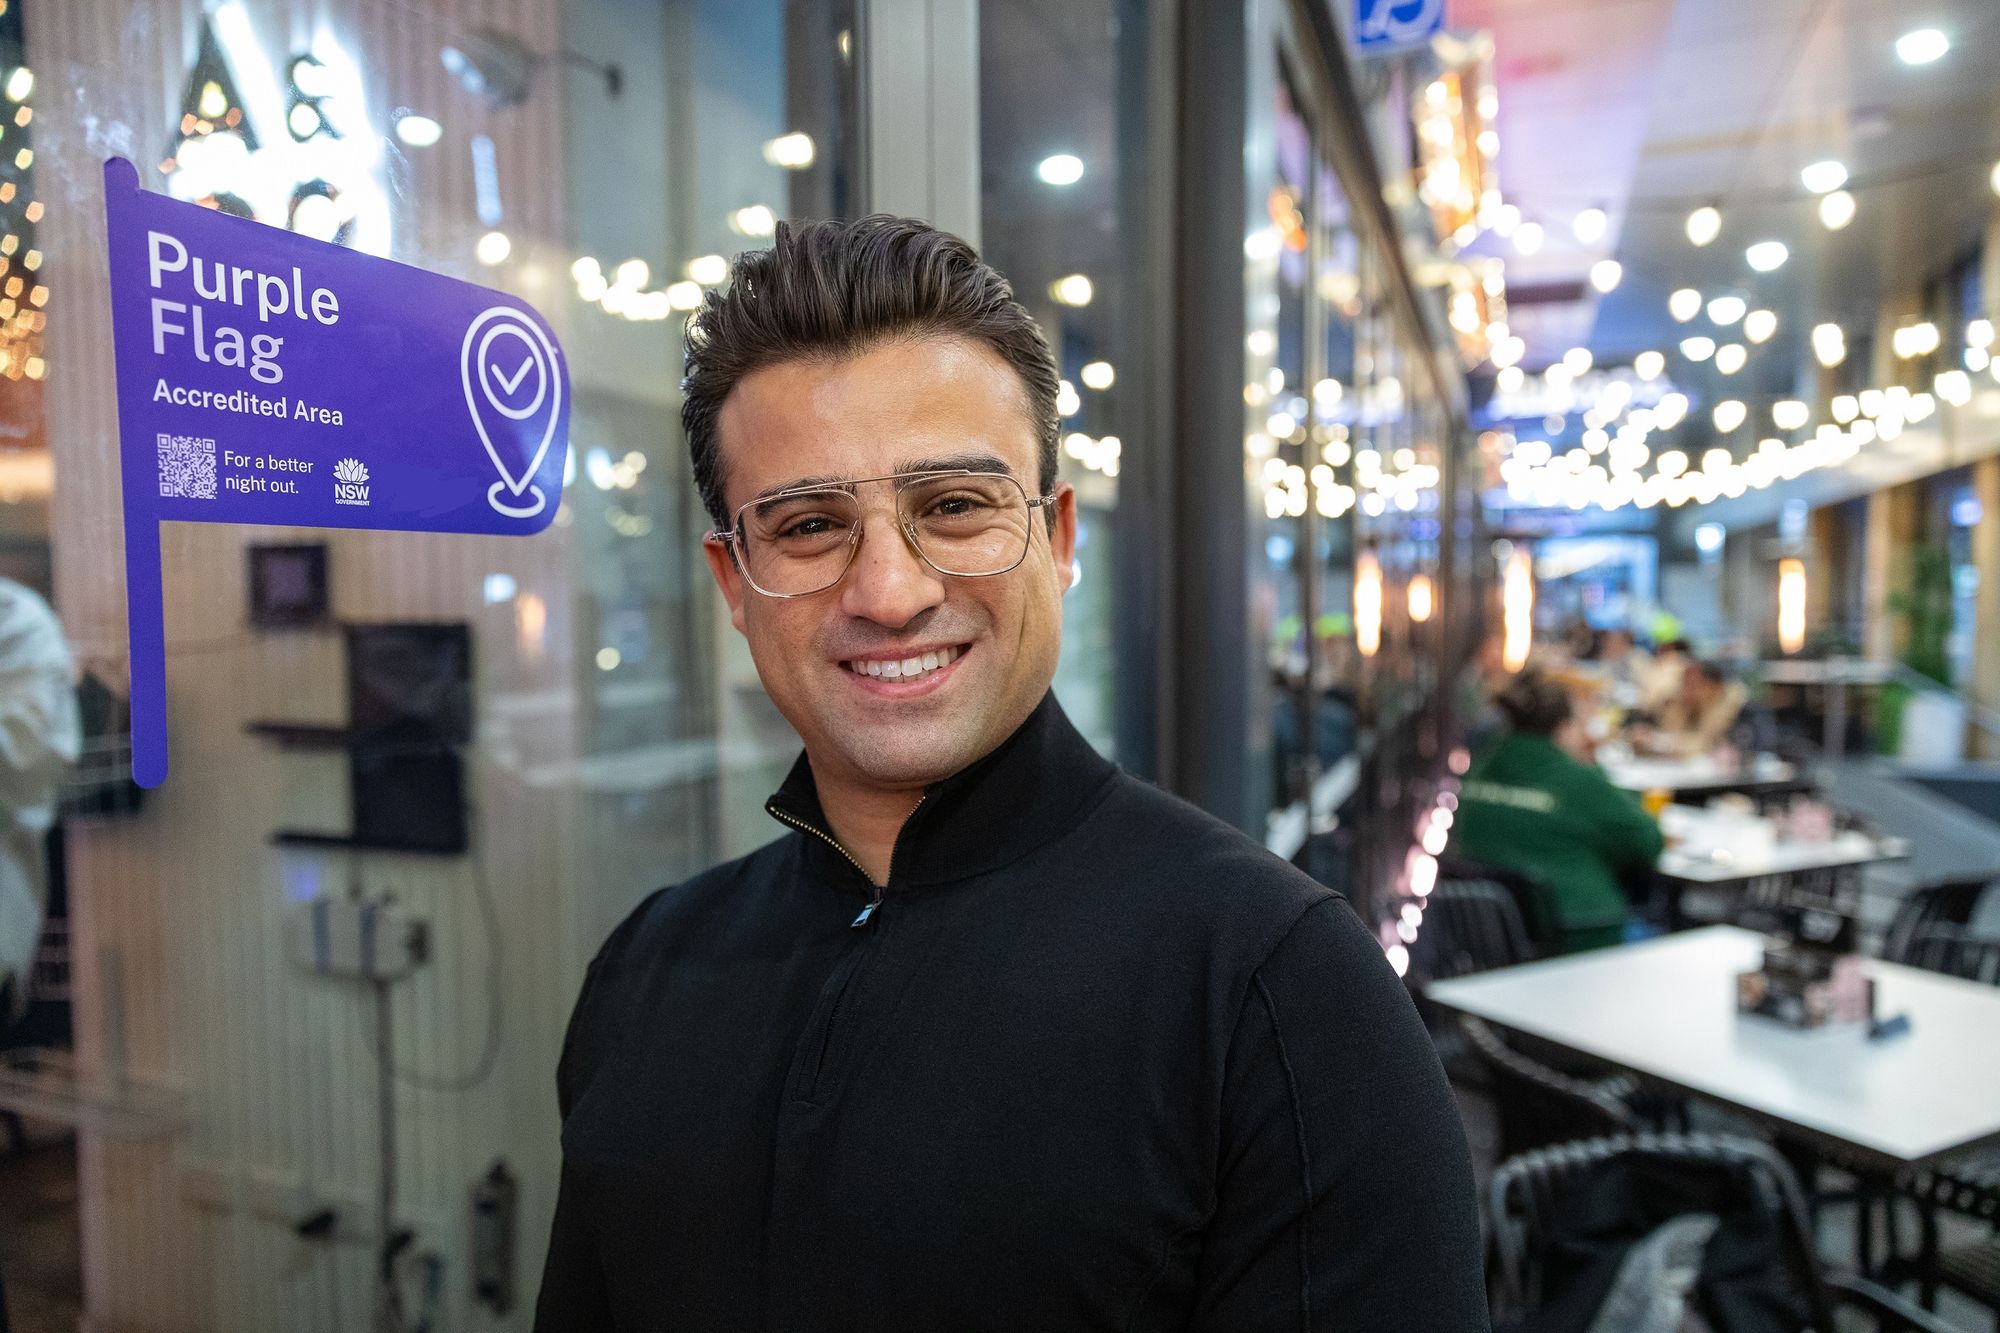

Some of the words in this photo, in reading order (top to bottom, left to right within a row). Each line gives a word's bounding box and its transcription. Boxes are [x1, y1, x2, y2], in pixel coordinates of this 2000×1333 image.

[148, 230, 340, 326] Purple
[151, 298, 284, 384] Flag
[152, 378, 288, 419] Accredited
[293, 399, 344, 427] Area
[224, 450, 251, 468] For
[255, 457, 265, 470] a
[268, 454, 314, 474] better
[225, 475, 267, 495] night
[270, 480, 300, 494] out.
[334, 483, 370, 501] NSW
[335, 498, 371, 507] GOVERNMENT
